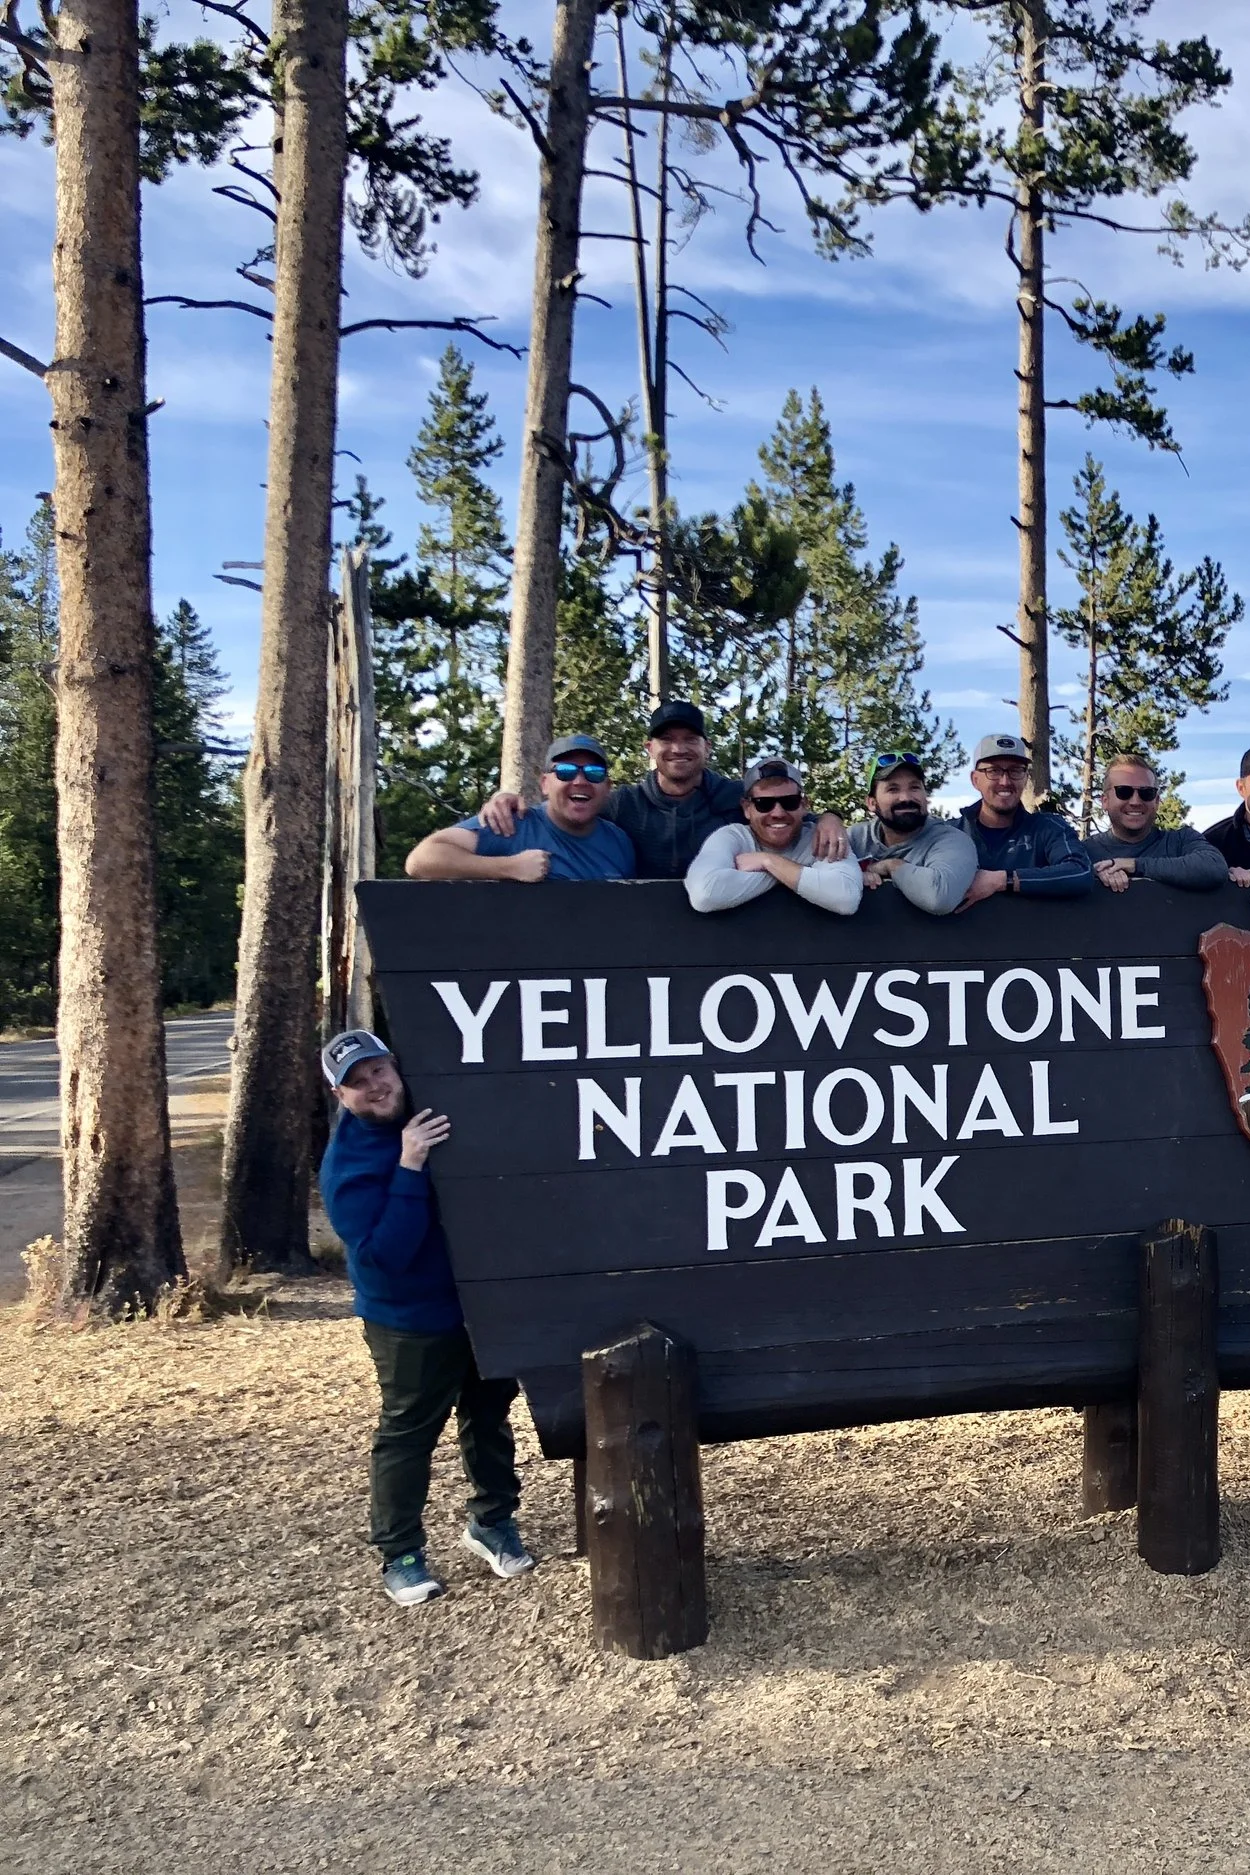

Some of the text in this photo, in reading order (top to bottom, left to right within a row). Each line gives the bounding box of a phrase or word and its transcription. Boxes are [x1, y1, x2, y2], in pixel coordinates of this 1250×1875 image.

[431, 965, 1166, 1063] YELLOWSTONE
[577, 1060, 1079, 1160] NATIONAL
[706, 1155, 966, 1251] PARK
